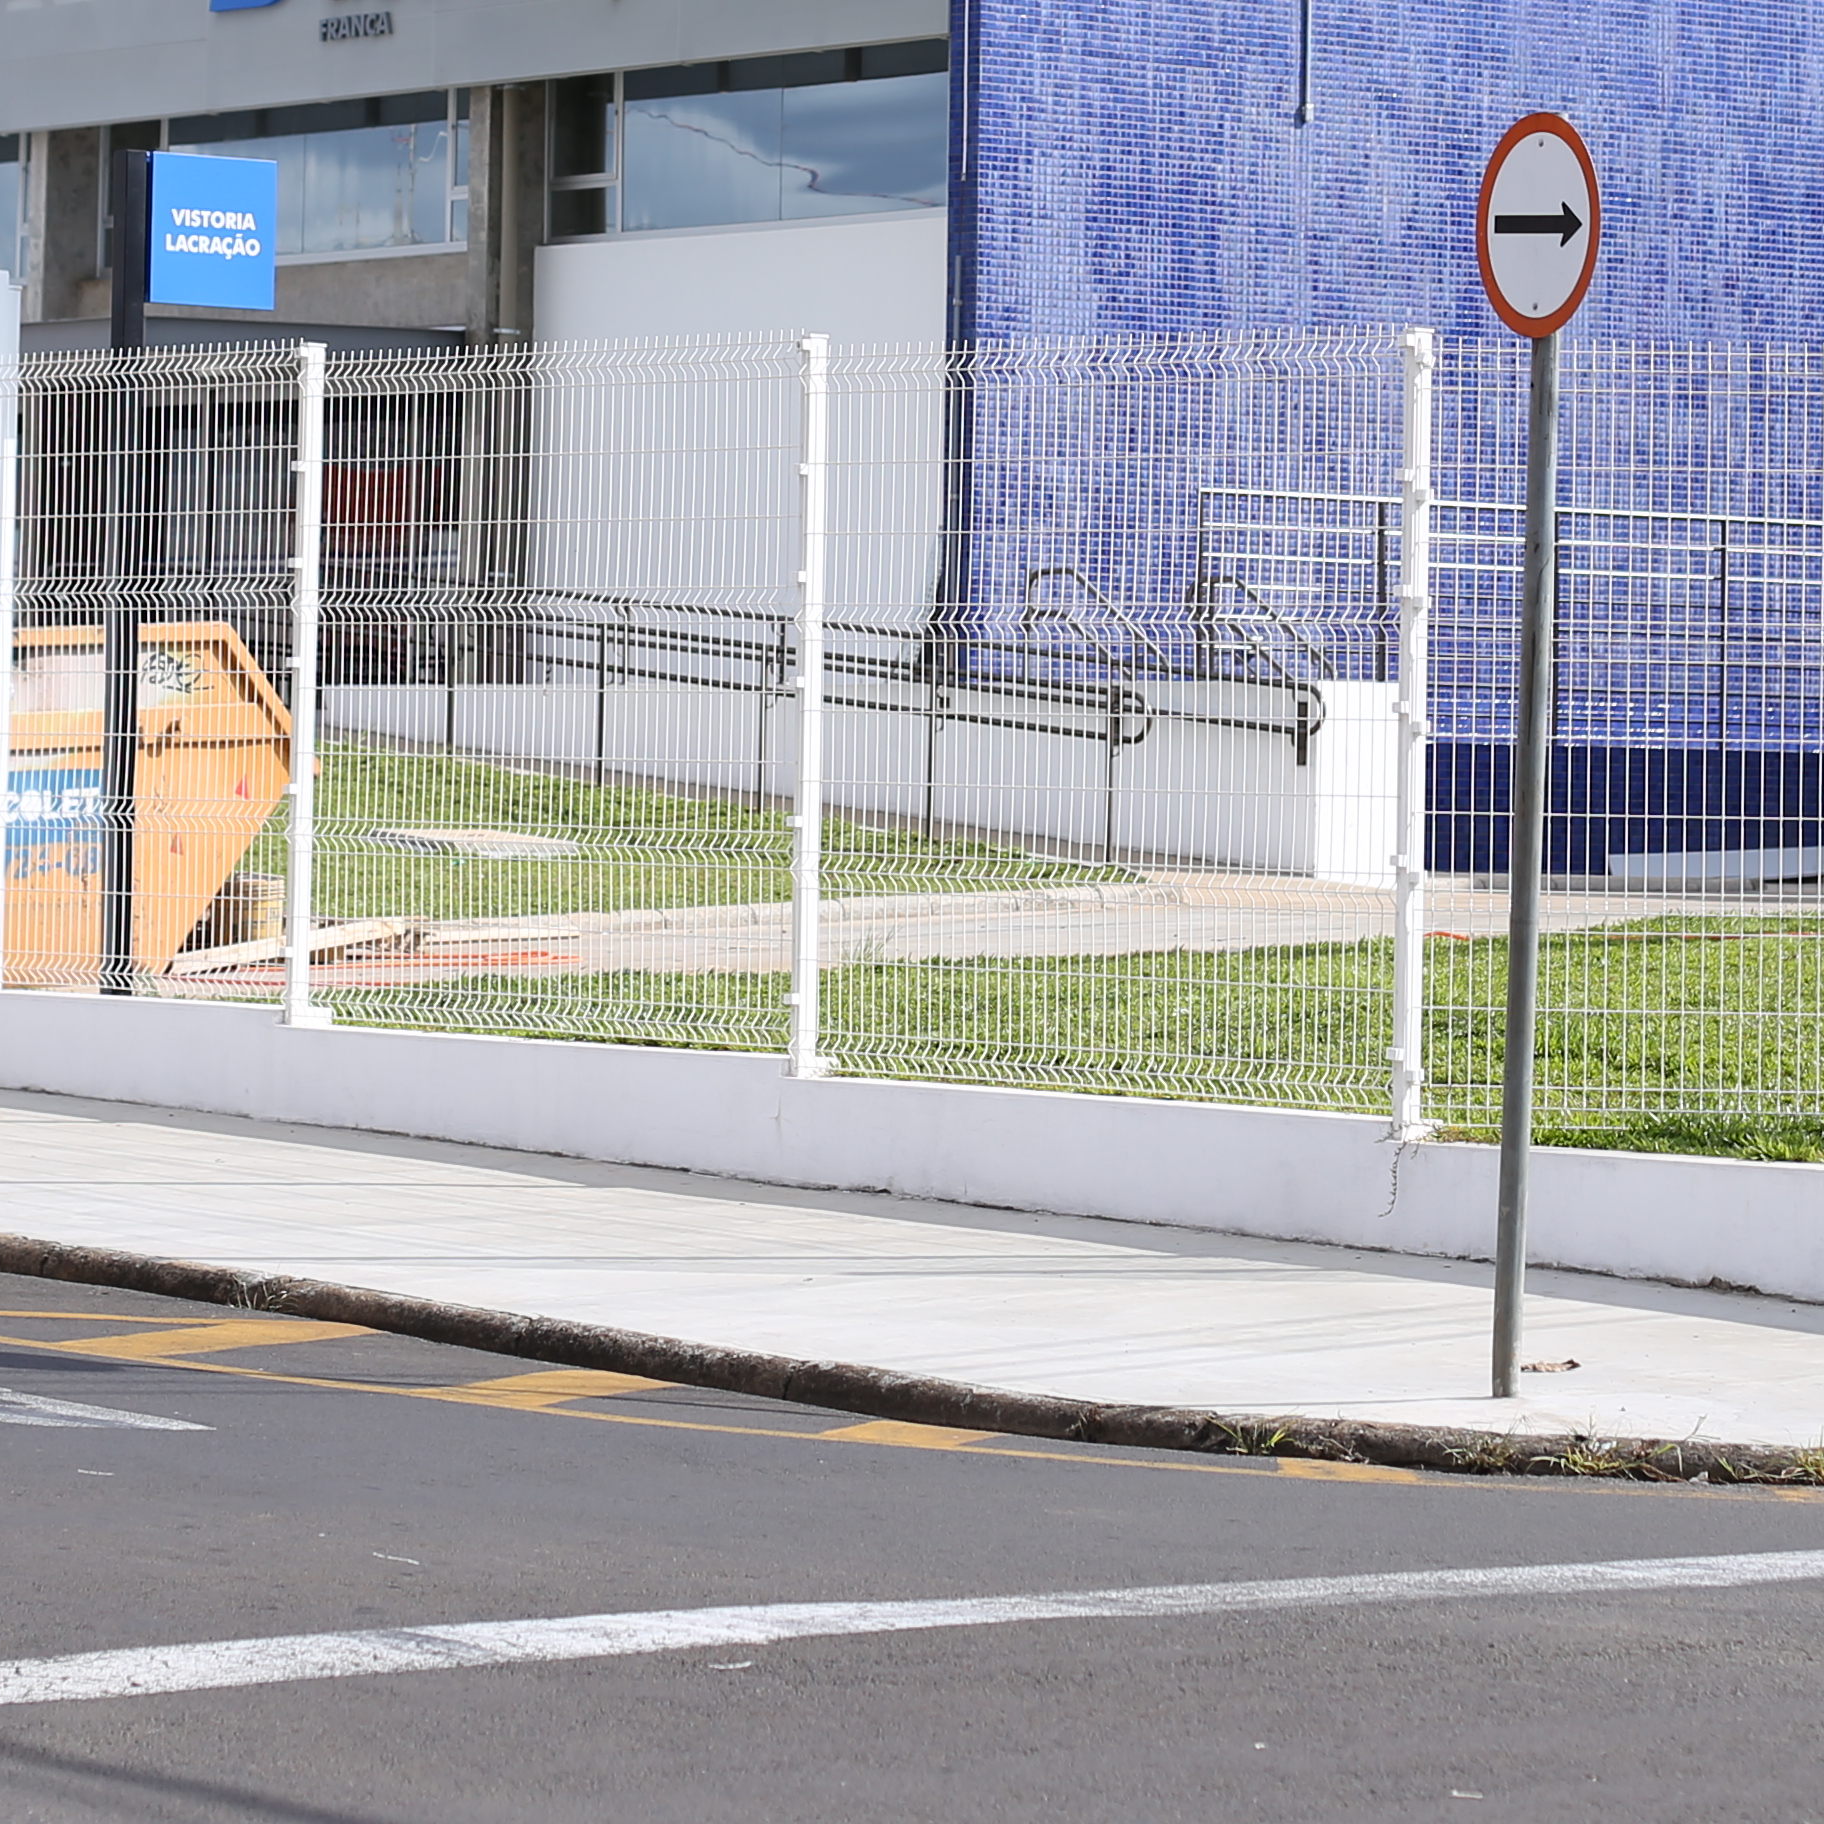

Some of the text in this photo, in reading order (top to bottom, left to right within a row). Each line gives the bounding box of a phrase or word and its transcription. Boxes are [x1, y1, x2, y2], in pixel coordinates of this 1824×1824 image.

[319, 11, 394, 42] FRANCA
[170, 208, 257, 231] VISTORIA
[165, 233, 261, 260] LACRAÇÃO
